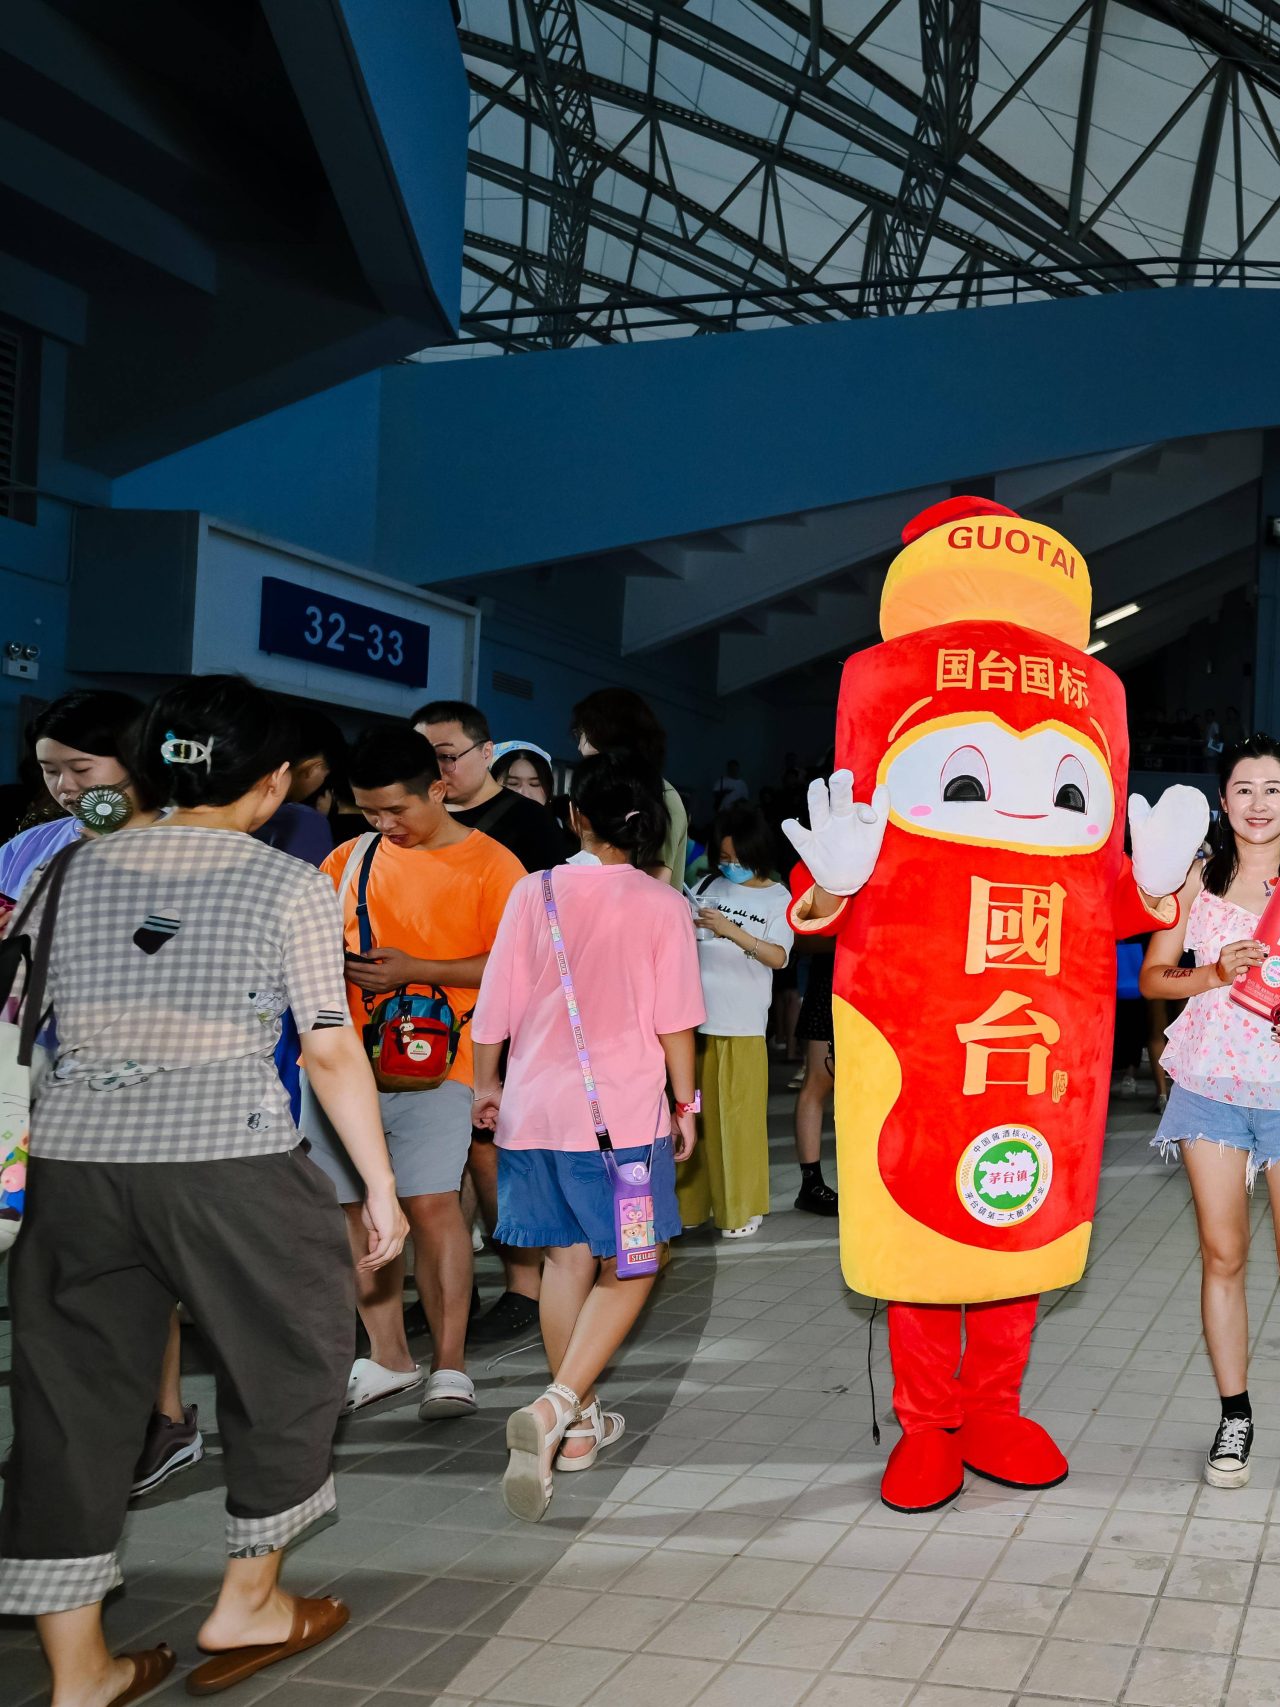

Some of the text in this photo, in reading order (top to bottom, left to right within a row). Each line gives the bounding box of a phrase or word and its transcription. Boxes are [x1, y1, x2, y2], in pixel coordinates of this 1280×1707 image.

[948, 525, 1076, 579] GUOTAI
[303, 605, 404, 666] 32-33
[936, 648, 1090, 710] 国台国标
[732, 909, 748, 917] all
[749, 914, 767, 924] the
[956, 875, 1068, 1096] 國台
[973, 1129, 1043, 1153] 中国酱酒核心产区
[989, 1170, 1028, 1184] 茅台镇
